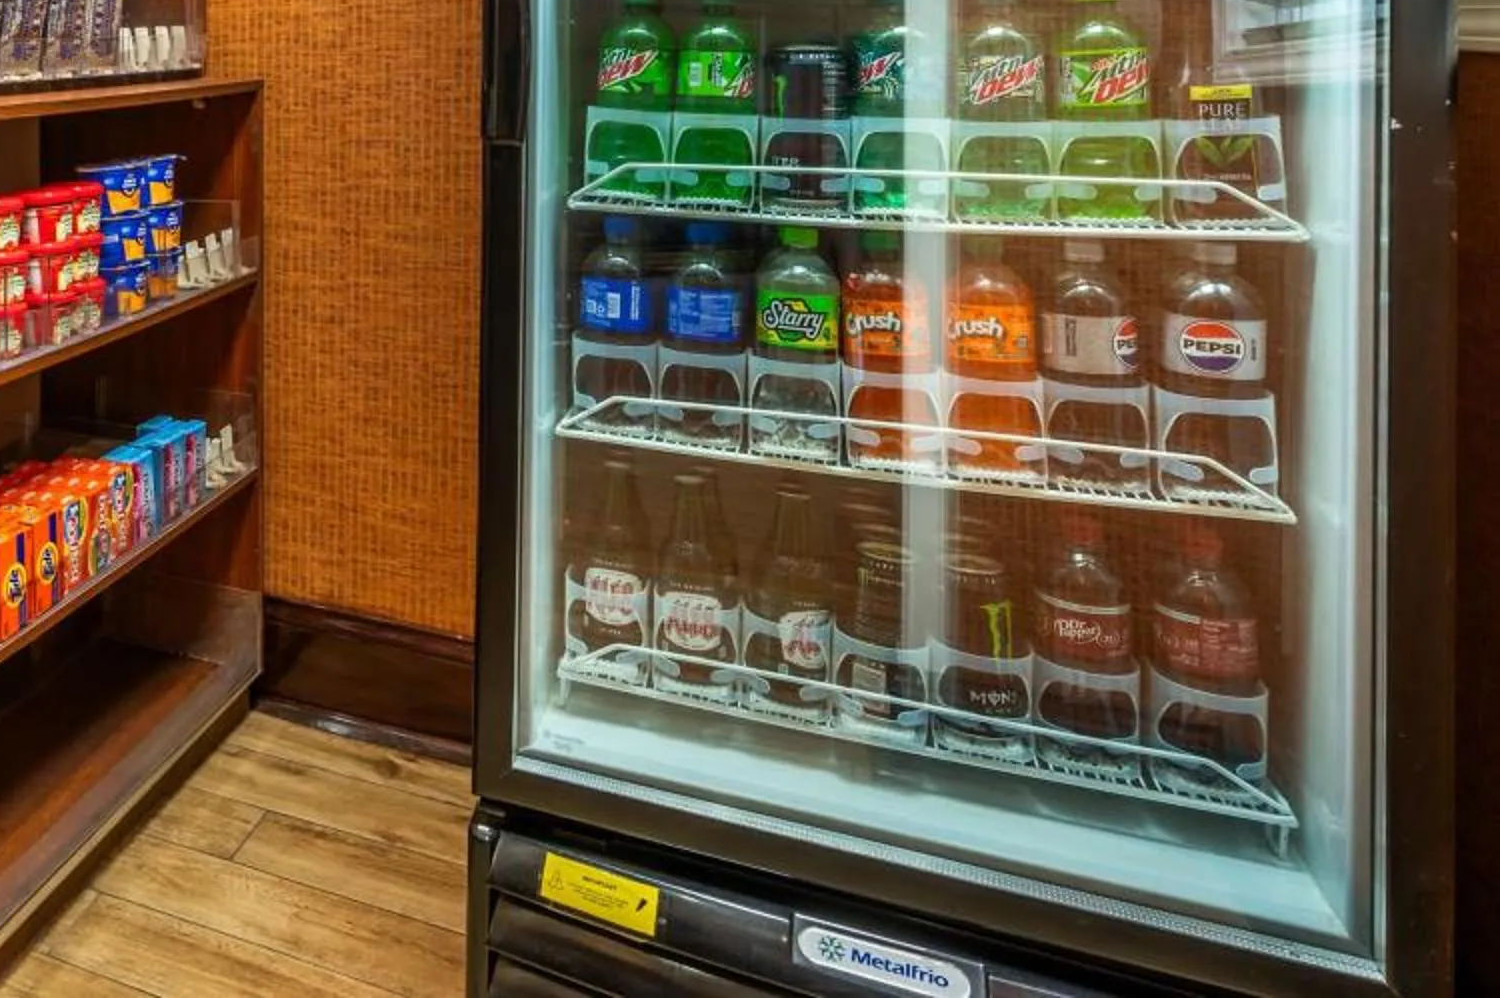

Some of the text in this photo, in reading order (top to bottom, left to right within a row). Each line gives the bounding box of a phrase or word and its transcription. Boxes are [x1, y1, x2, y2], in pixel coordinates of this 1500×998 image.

[1198, 103, 1247, 118] PURE
[763, 300, 825, 337] Starry
[1182, 337, 1242, 356] PEPSI
[850, 946, 950, 989] Metalfrio
